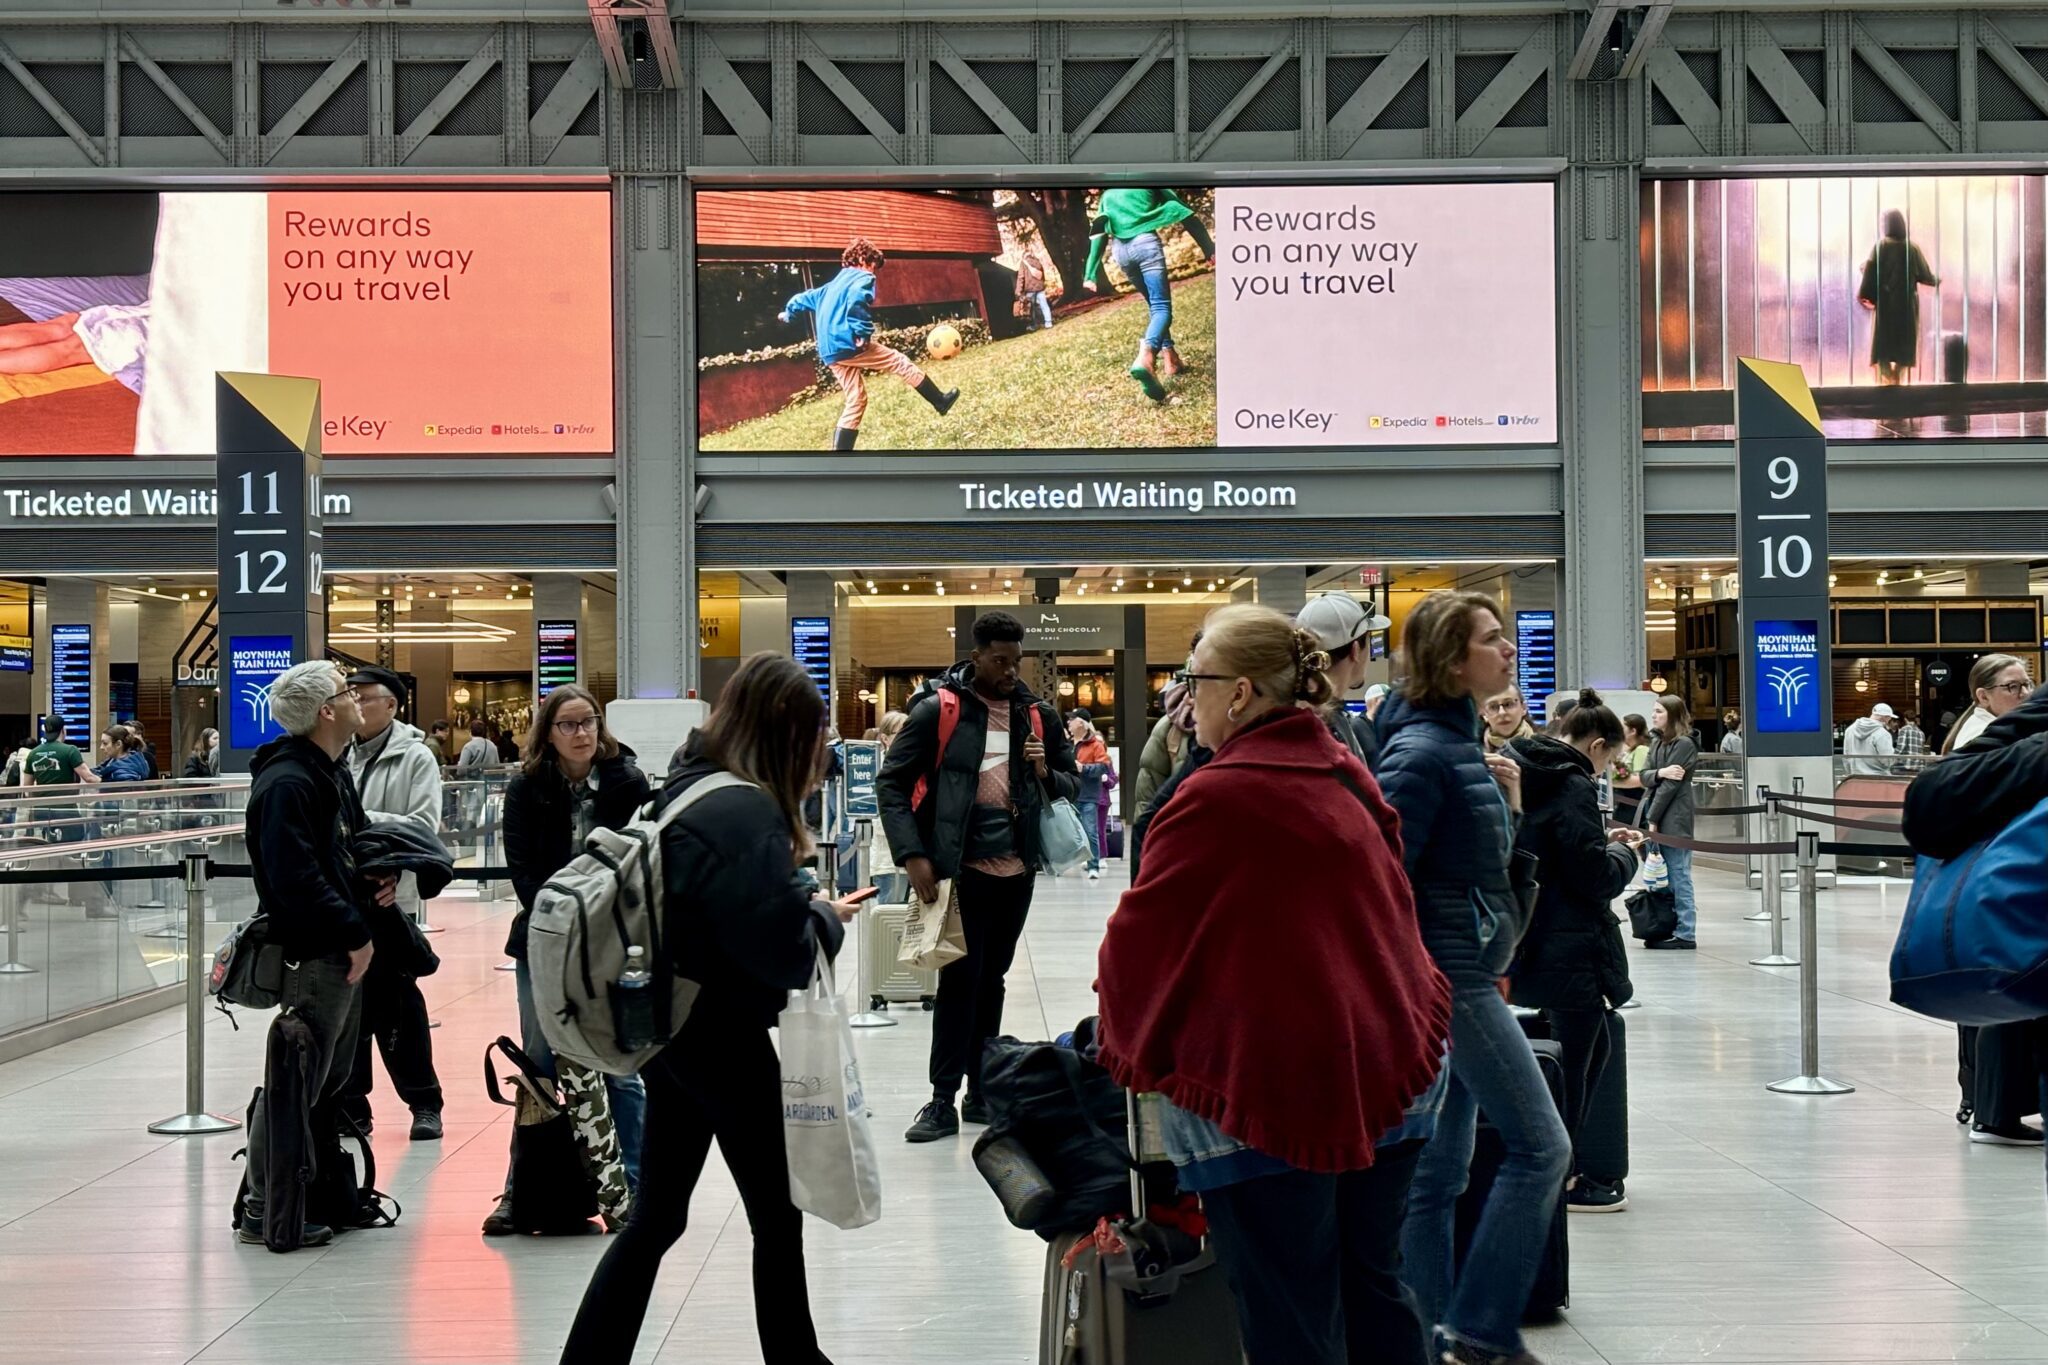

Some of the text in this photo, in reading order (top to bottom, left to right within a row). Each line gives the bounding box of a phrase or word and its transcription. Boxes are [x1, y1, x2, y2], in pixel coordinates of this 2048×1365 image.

[285, 210, 431, 237] Rewards
[1233, 204, 1376, 232] Rewards
[284, 248, 474, 275] on any way
[1231, 241, 1418, 268] on any way
[284, 274, 451, 306] you travel
[1231, 267, 1396, 301] you travel
[324, 415, 387, 441] eKey
[437, 424, 483, 437] Expedia
[1383, 416, 1427, 429] Expedia
[1767, 456, 1799, 500] 9
[3, 489, 217, 516] Ticketed Waiti
[237, 471, 283, 515] 11
[959, 480, 1297, 512] Ticketed Waiting Room
[1758, 534, 1812, 579] 10
[234, 550, 288, 594] 12
[1757, 643, 1817, 653] TRAIN HALL
[1758, 634, 1816, 645] MOYNIHAN
[232, 659, 292, 669] TRAIN HALL
[233, 650, 291, 660] MOYNIHAN
[851, 753, 872, 765] Enter
[853, 768, 871, 780] here
